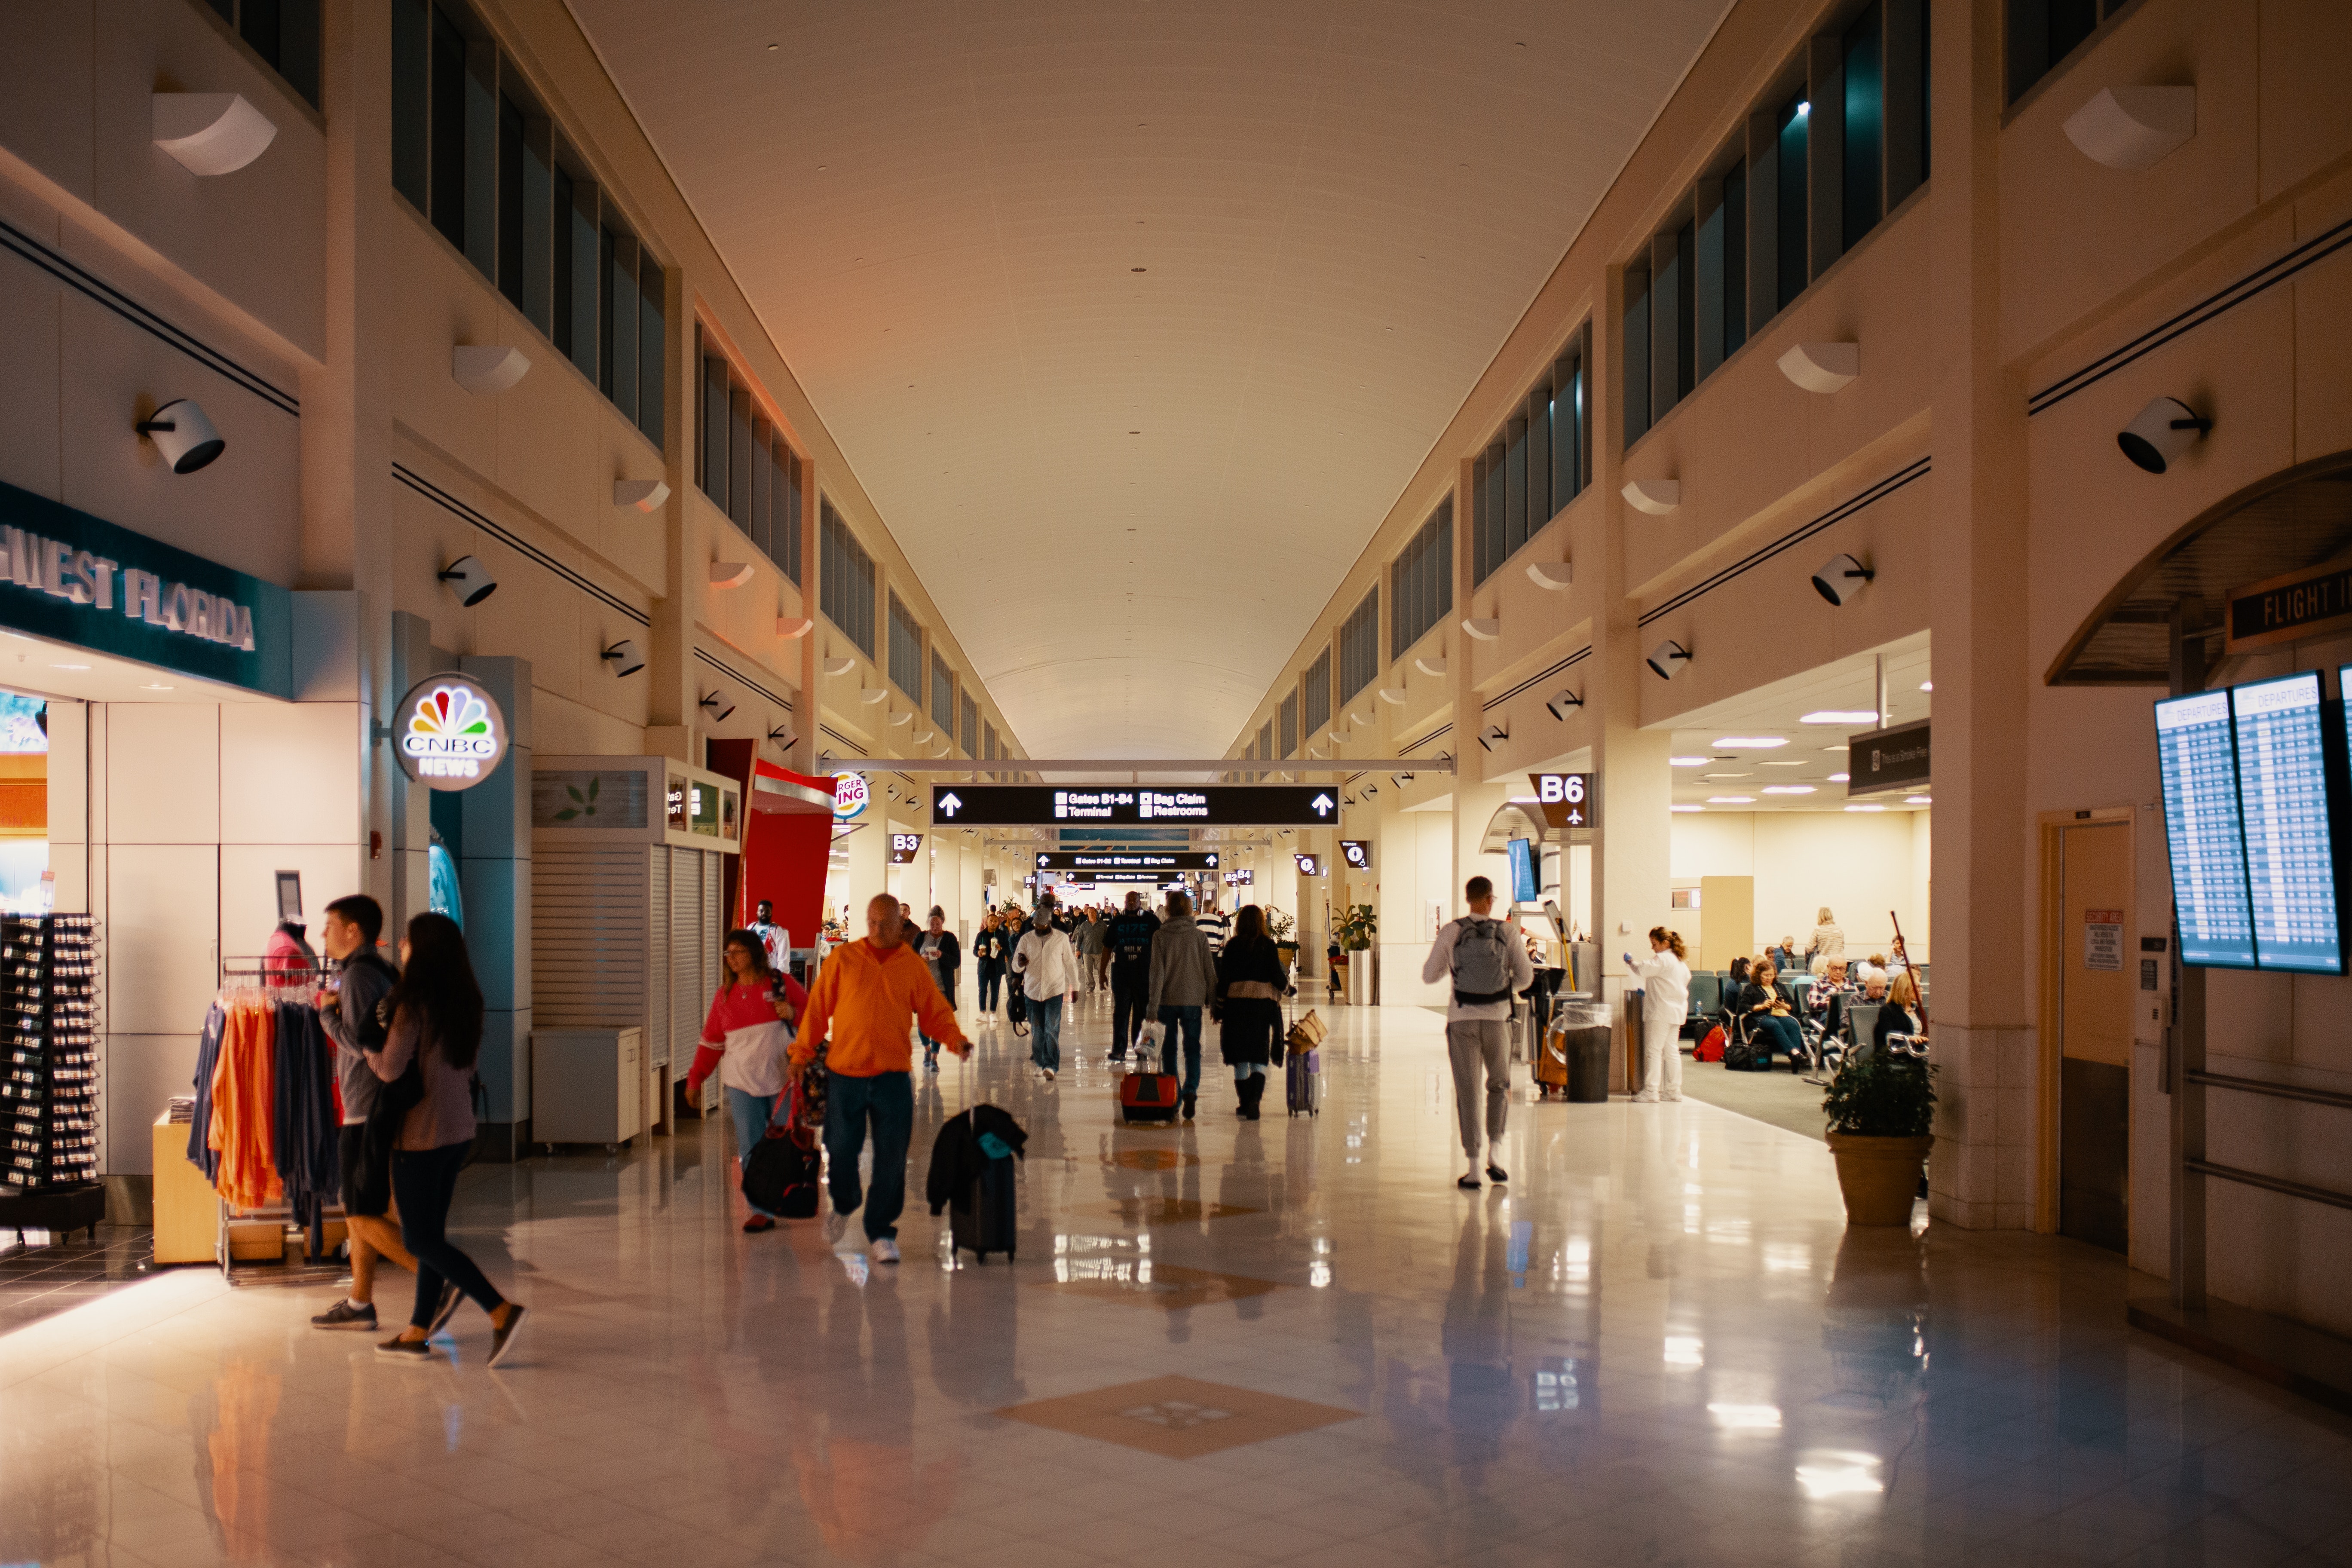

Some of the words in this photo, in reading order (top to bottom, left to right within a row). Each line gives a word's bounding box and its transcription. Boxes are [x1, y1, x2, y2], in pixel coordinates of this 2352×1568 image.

[2264, 582, 2331, 626] FLIGHT
[2340, 576, 2352, 607] I
[124, 568, 255, 651] FLORIDA
[2258, 686, 2317, 707] DEPARTURES
[2177, 702, 2228, 721] DEPARTURES
[407, 737, 491, 754] CNBC
[419, 758, 479, 777] NEWS
[1540, 776, 1584, 803] B6
[1069, 793, 1099, 804] Gates
[1101, 793, 1133, 804] B1-B4
[1154, 793, 1175, 806] Bag
[1176, 793, 1206, 804] Claim
[1068, 806, 1112, 817] Terminal
[1154, 806, 1208, 816] Restrooms
[893, 835, 917, 850] B3
[1237, 870, 1251, 879] B4
[2086, 912, 2109, 922] SECURITY
[2110, 912, 2123, 922] AREA
[1118, 924, 1148, 933] SIZE
